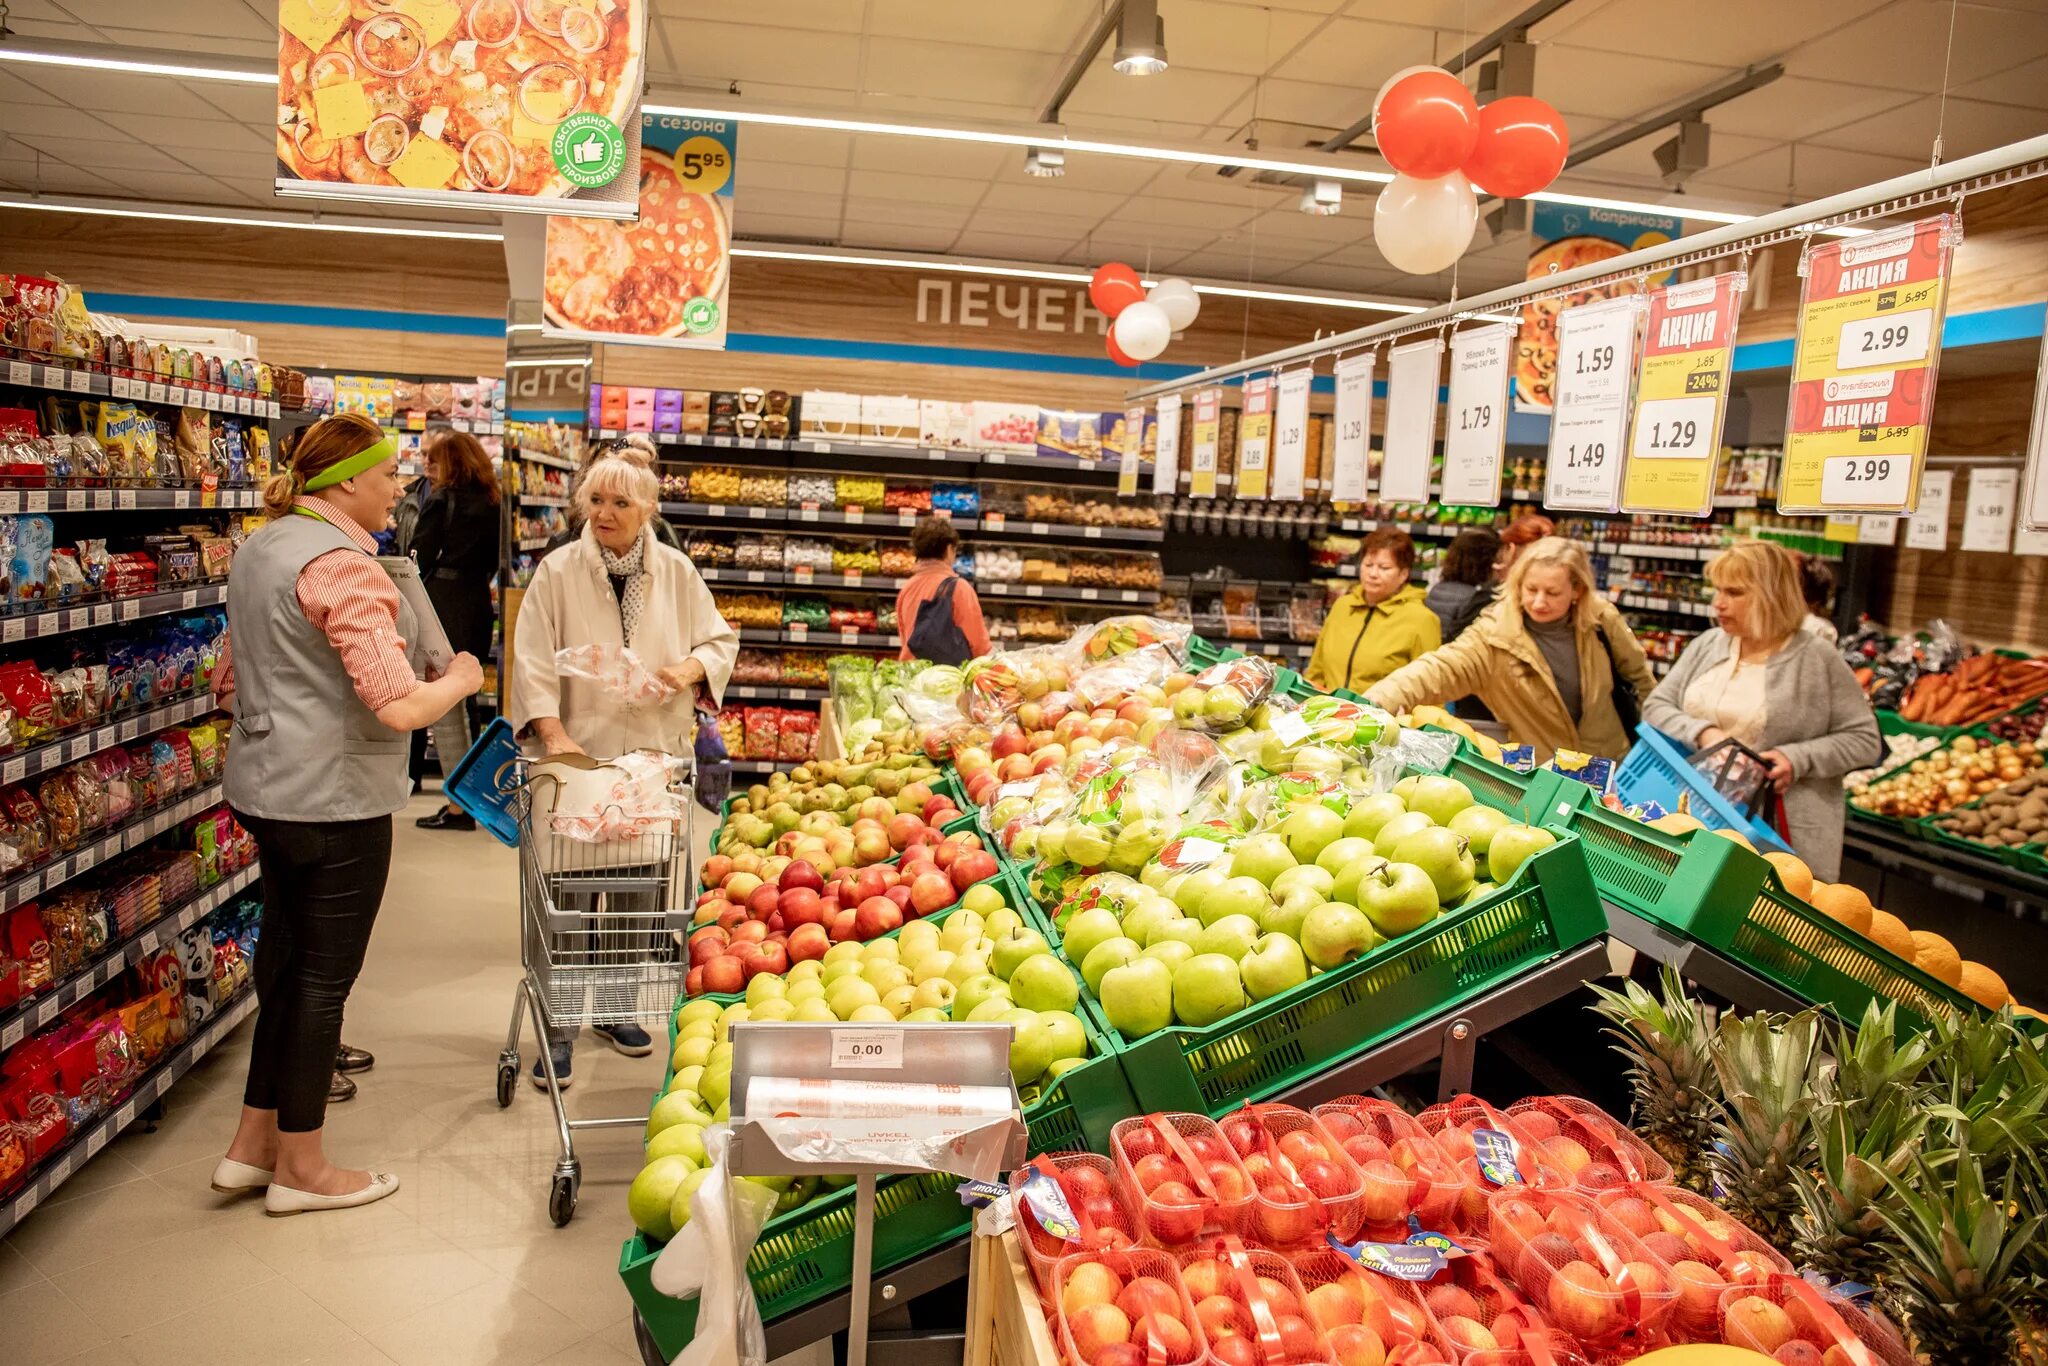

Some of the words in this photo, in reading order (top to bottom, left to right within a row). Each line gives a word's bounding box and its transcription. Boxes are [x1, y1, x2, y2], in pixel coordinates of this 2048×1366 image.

[555, 115, 612, 156] СОБСТВЕННОЕ
[660, 116, 726, 134] сезона
[560, 139, 623, 185] ПРОИЗВОДСТВО
[1589, 208, 1675, 231] Капричоза
[1838, 258, 1909, 294] АКЦИЯ
[1904, 289, 1928, 304] 6.99
[917, 279, 1183, 341] ПЕЧЕН
[1658, 310, 1718, 349] АКЦИЯ
[1861, 324, 1909, 353] 2.99
[1576, 345, 1614, 374] 1.59
[1696, 355, 1715, 368] 1.69
[1688, 374, 1718, 390] -24%
[106, 413, 136, 438] Nesqui
[1461, 404, 1491, 430] 1.79
[1822, 401, 1888, 428] АКЦИЯ
[1282, 428, 1299, 445] 1.29
[1343, 421, 1361, 440] 1.29
[1649, 420, 1697, 448] 1.29
[1886, 427, 1909, 437] 6.99
[1567, 442, 1605, 468] 1.49
[1845, 459, 1890, 481] 2.99
[852, 1044, 883, 1055] 0.00
